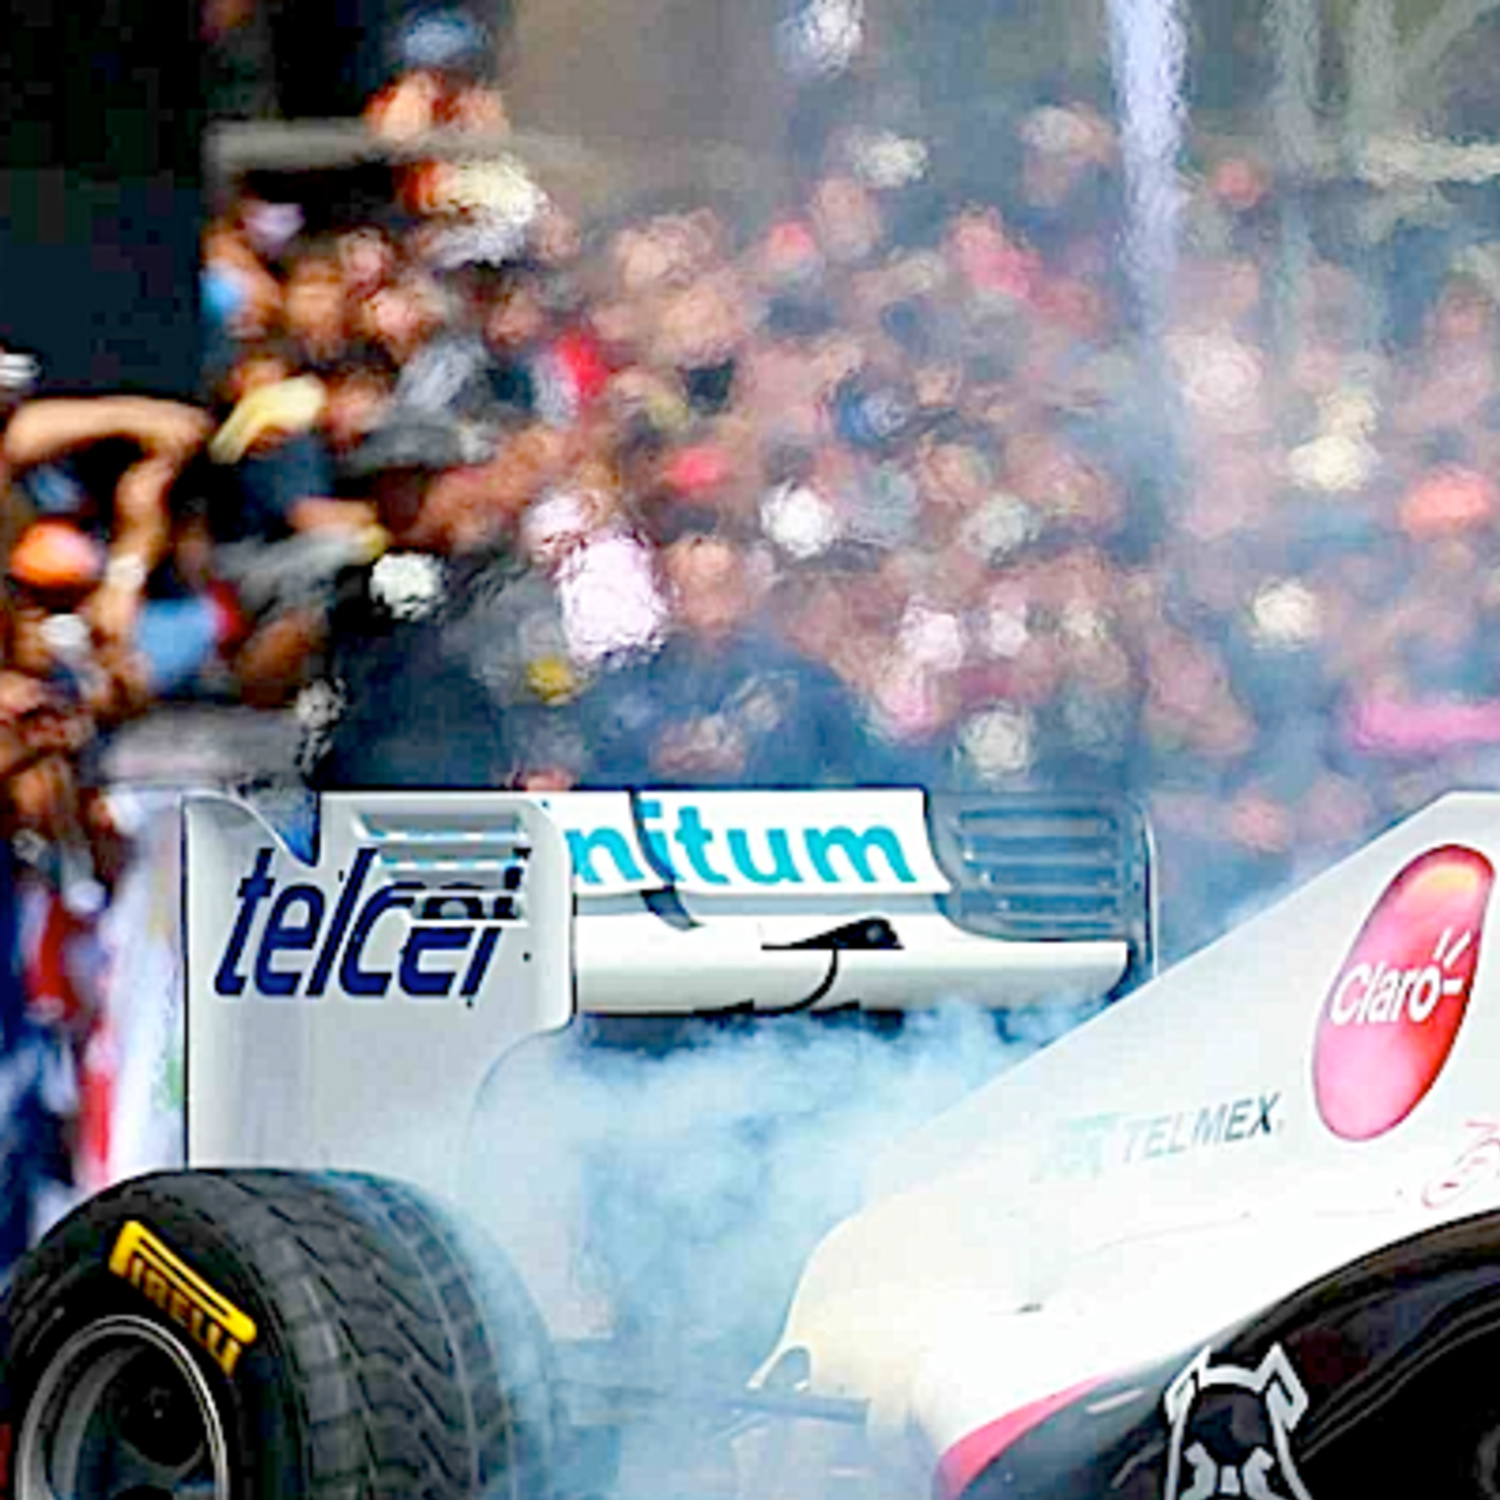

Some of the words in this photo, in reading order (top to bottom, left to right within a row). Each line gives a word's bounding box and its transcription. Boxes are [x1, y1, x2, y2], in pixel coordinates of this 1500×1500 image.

[1329, 957, 1439, 1025] Claro
[1121, 1090, 1282, 1164] TELMEX
[108, 1220, 257, 1376] PIRELLI
